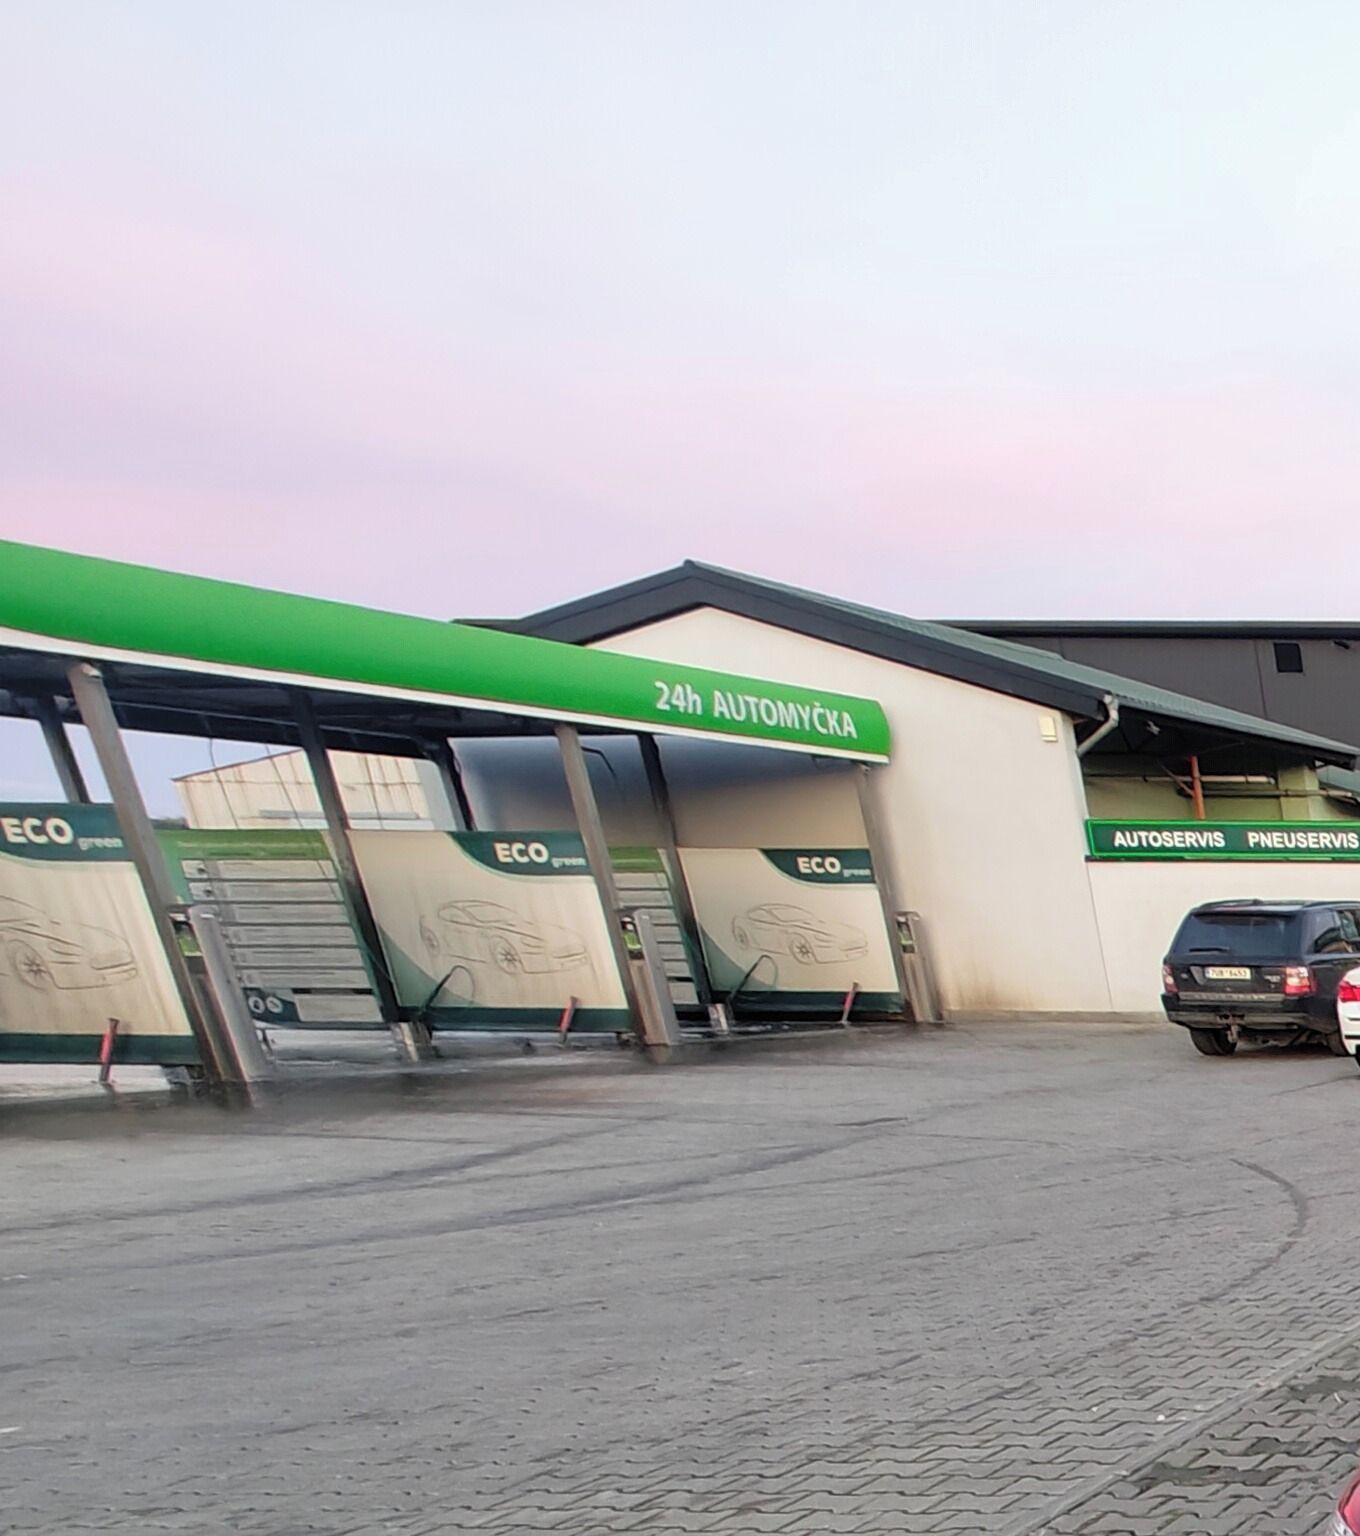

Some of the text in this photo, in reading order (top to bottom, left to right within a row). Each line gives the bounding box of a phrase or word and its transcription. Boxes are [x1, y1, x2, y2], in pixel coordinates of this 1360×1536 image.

[654, 681, 858, 739] 24h AUTOMYČKA
[0, 817, 74, 845] ECO
[1114, 831, 1225, 848] AUTOSERVIS
[1247, 831, 1359, 849] PNEUSERVIS
[494, 842, 549, 863] ECO
[796, 856, 841, 874] ECO
